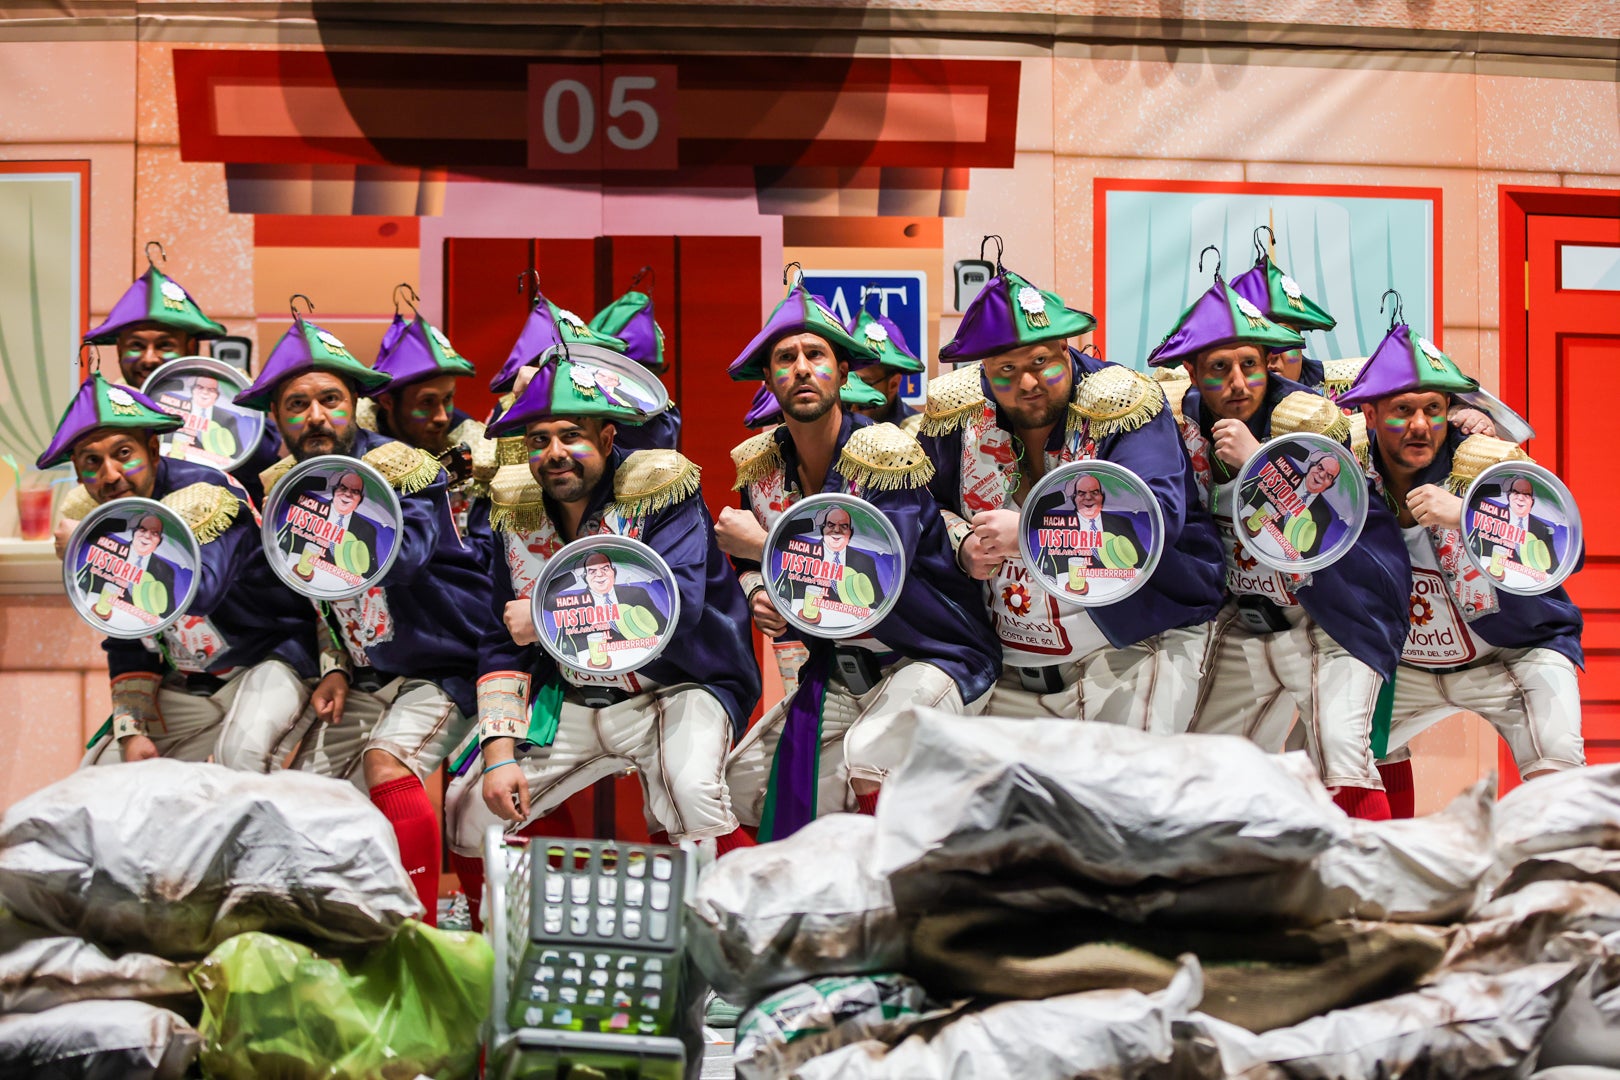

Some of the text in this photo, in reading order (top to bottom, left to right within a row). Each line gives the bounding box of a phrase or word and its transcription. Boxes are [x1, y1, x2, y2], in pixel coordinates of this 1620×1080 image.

[543, 76, 659, 154] 05
[1275, 456, 1301, 487] HACIA LA
[1258, 461, 1308, 518] VISTORIA
[297, 495, 330, 516] HACIA LA
[1480, 501, 1509, 520] HACIA LA
[286, 504, 345, 544] VISTORIA
[1043, 516, 1078, 526] HACIA LA
[1473, 510, 1527, 545] VISTORIA
[789, 540, 822, 556] HACIA LA
[1039, 529, 1103, 548] VISTORIA
[86, 545, 143, 584] VISTORIA
[781, 552, 844, 581] VISTORIA
[1082, 556, 1093, 566] AL
[556, 594, 592, 607] HACIA LA
[553, 603, 620, 629] VISTORIA
[602, 630, 613, 640] AL
[1002, 631, 1024, 641] COSTA
[1041, 638, 1056, 646] SOL
[1402, 648, 1424, 656] COSTA
